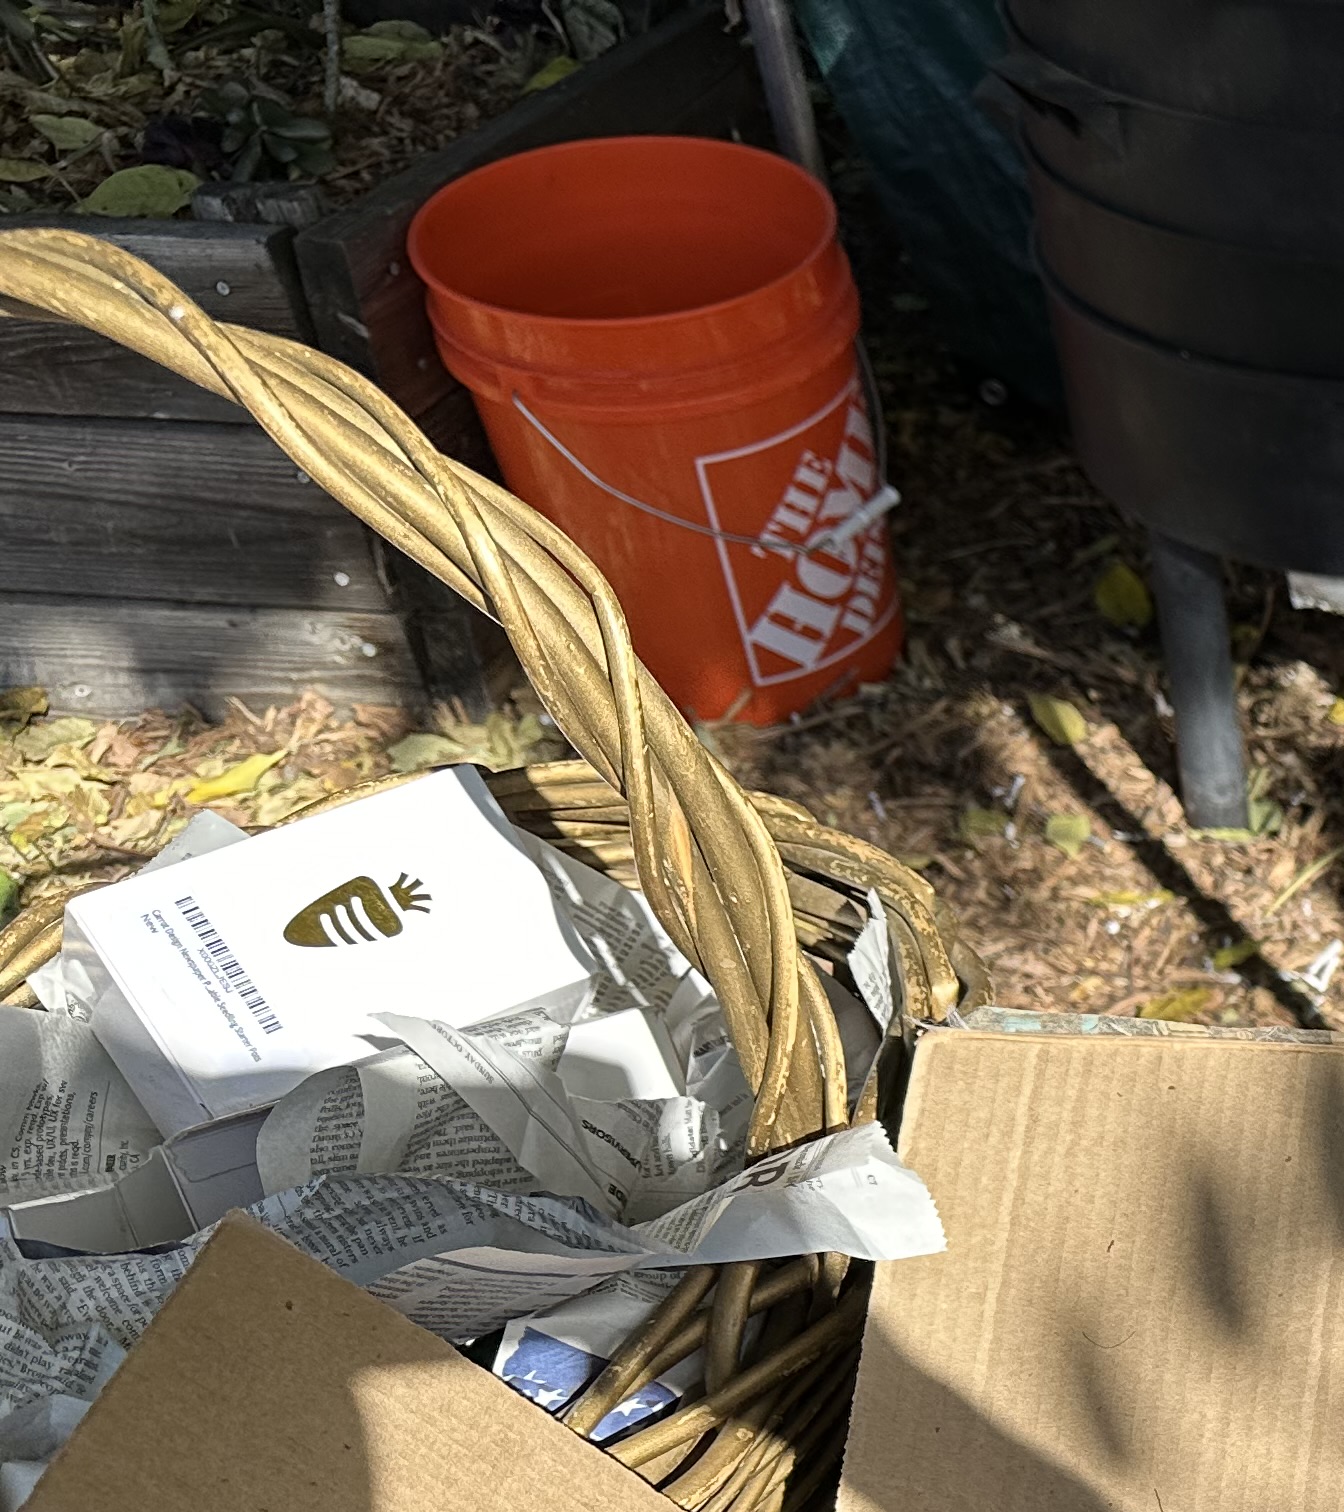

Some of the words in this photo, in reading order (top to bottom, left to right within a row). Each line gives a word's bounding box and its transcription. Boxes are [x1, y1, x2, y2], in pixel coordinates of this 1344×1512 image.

[752, 450, 833, 565] THE
[141, 914, 158, 933] New
[152, 910, 170, 929] Carrot
[165, 928, 182, 948] Design
[217, 1002, 238, 1029] Seedling
[465, 1053, 495, 1085] SUNDAY
